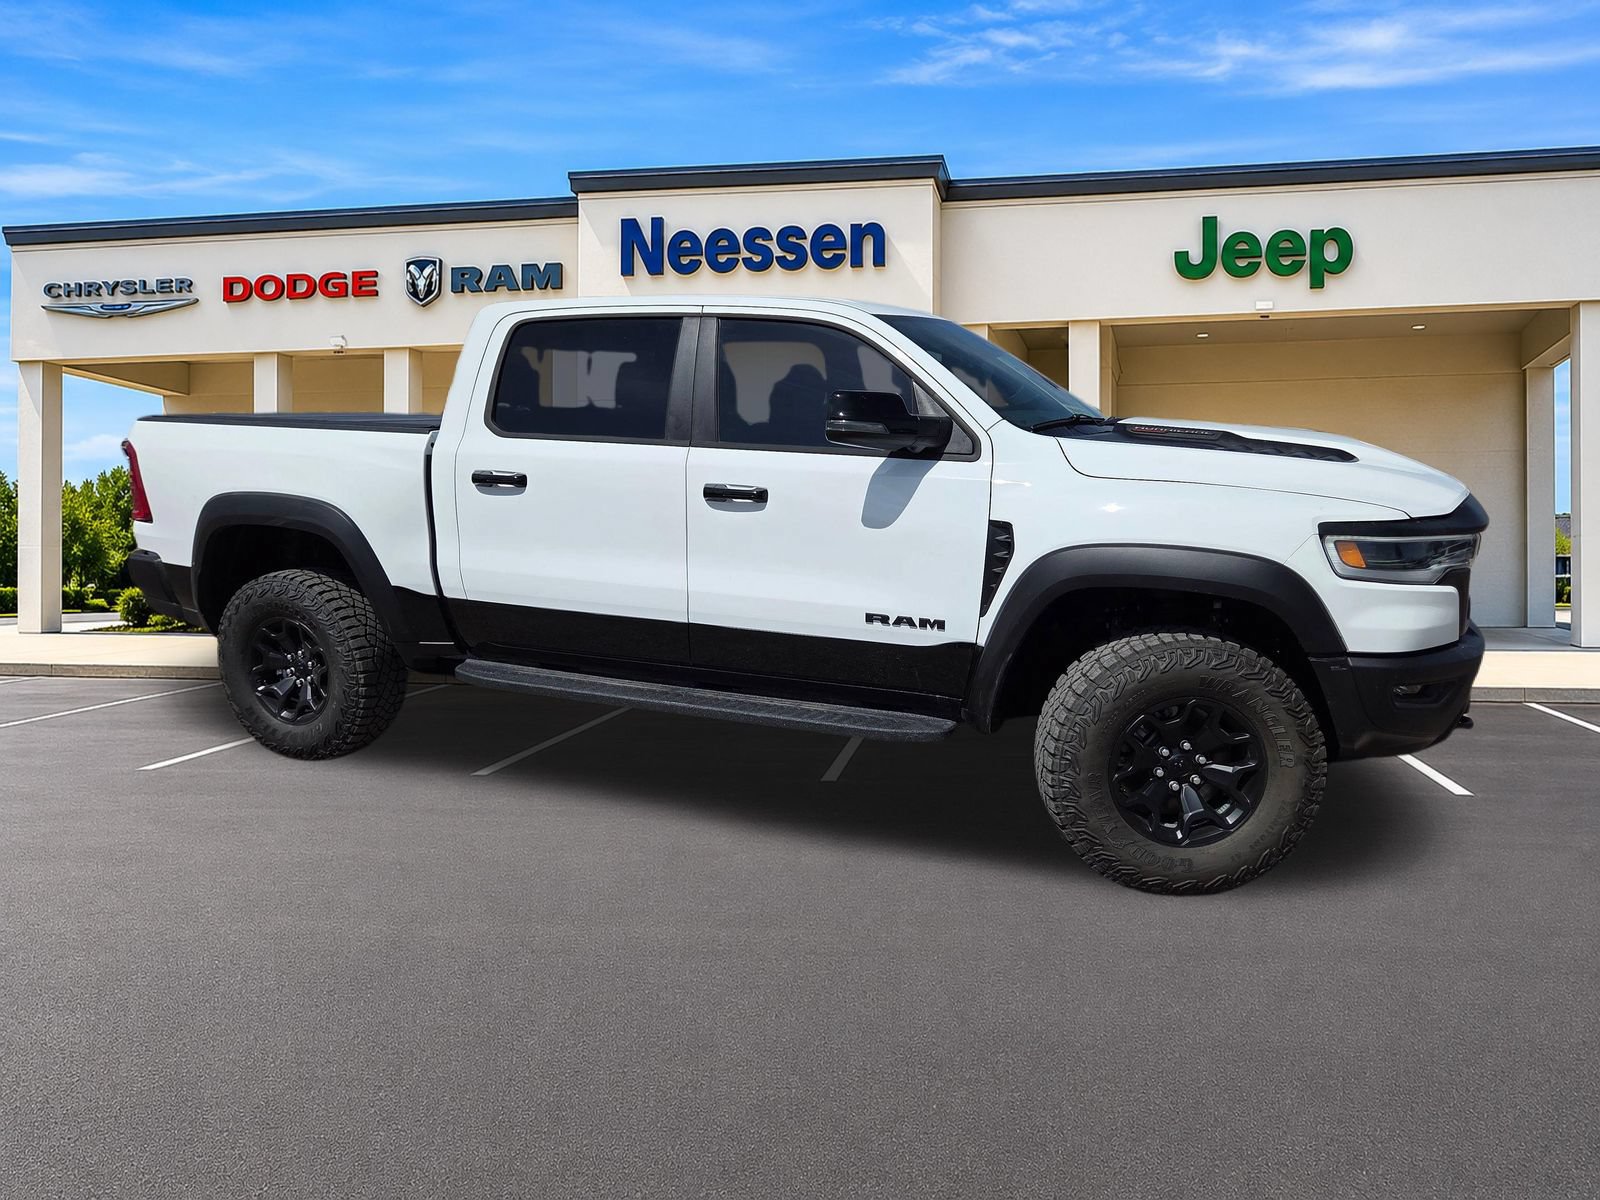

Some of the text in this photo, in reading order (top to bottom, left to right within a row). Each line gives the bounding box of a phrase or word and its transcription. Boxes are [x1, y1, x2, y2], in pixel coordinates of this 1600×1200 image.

[620, 216, 886, 276] Neessen
[1174, 216, 1354, 289] Jeep
[43, 278, 193, 298] CHRYSLER
[223, 270, 379, 303] DODGE
[451, 262, 563, 293] RAM
[865, 612, 946, 632] RAM
[1198, 674, 1295, 769] WRANGLER
